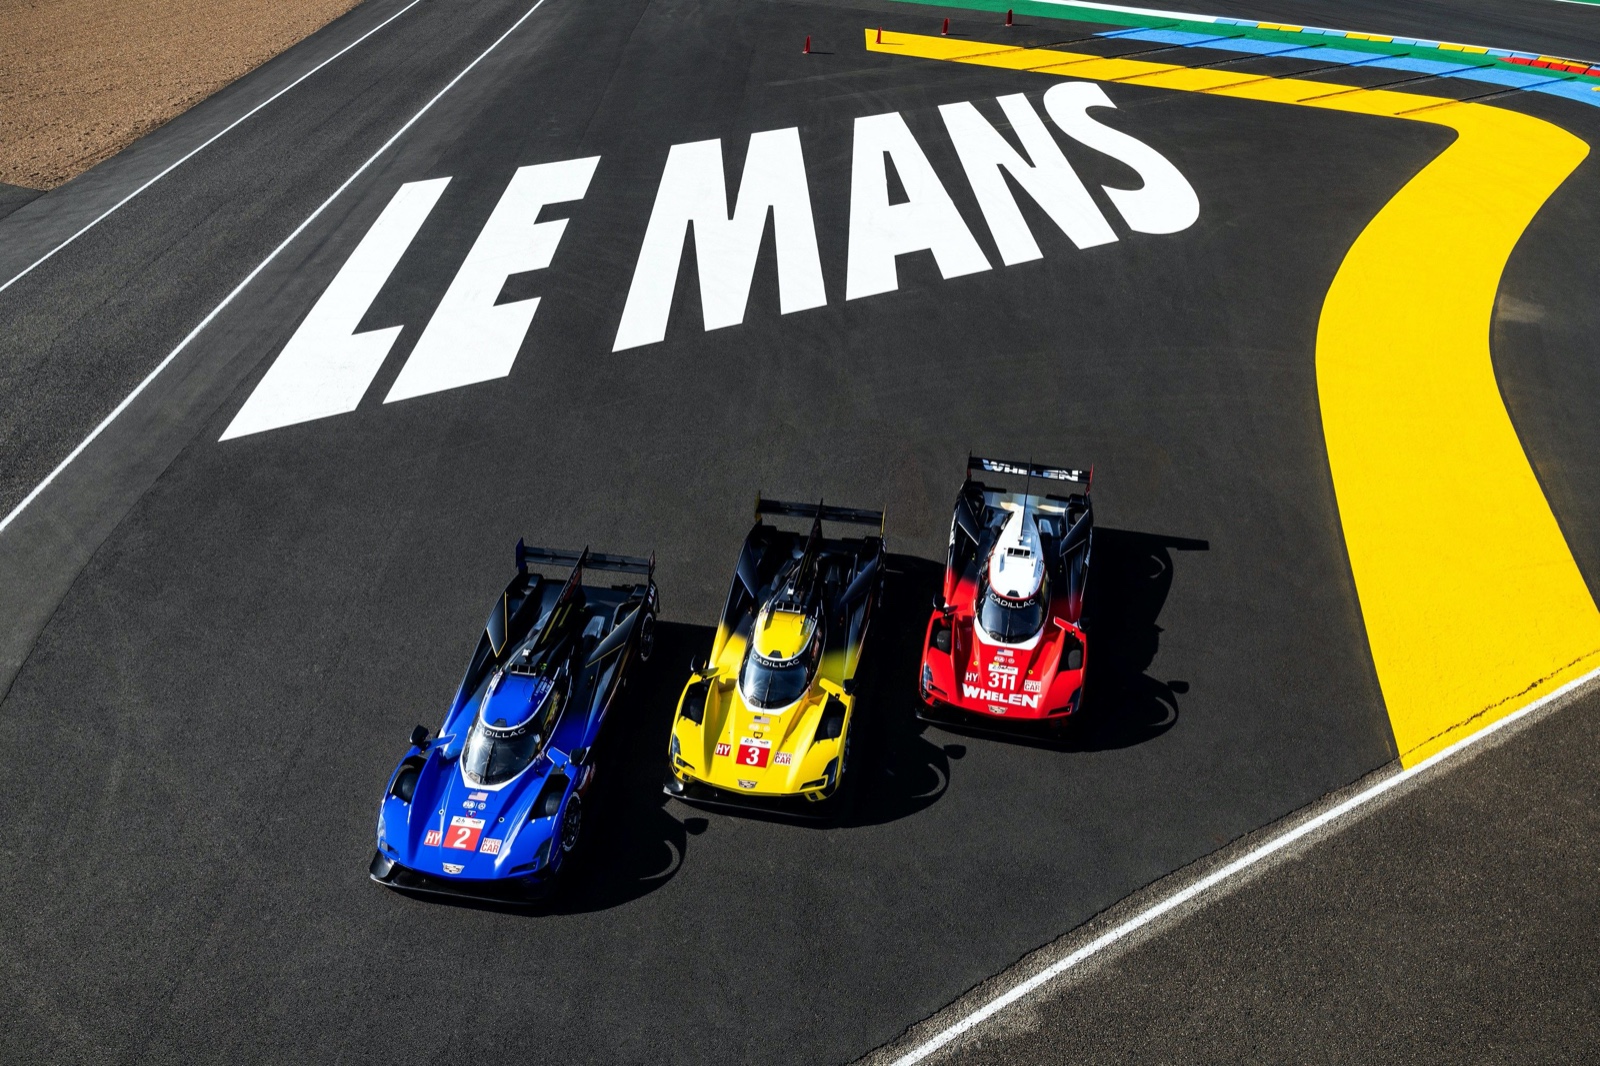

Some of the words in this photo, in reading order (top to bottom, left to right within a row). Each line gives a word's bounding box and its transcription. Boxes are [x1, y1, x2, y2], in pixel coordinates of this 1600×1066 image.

[217, 155, 602, 443] LE
[611, 81, 1200, 353] MANS
[982, 458, 1079, 482] WHELEN
[989, 593, 1036, 609] CADILLAC
[752, 653, 800, 668] CADILLAC
[965, 671, 979, 682] HY
[988, 672, 1016, 690] 311
[962, 683, 1039, 709] WHELEN
[479, 726, 526, 738] ADILLAC
[716, 744, 731, 755] HY
[745, 747, 760, 765] 3
[774, 756, 791, 764] CAR
[425, 832, 441, 845] HY
[453, 827, 471, 849] 2
[481, 844, 499, 853] CAR
